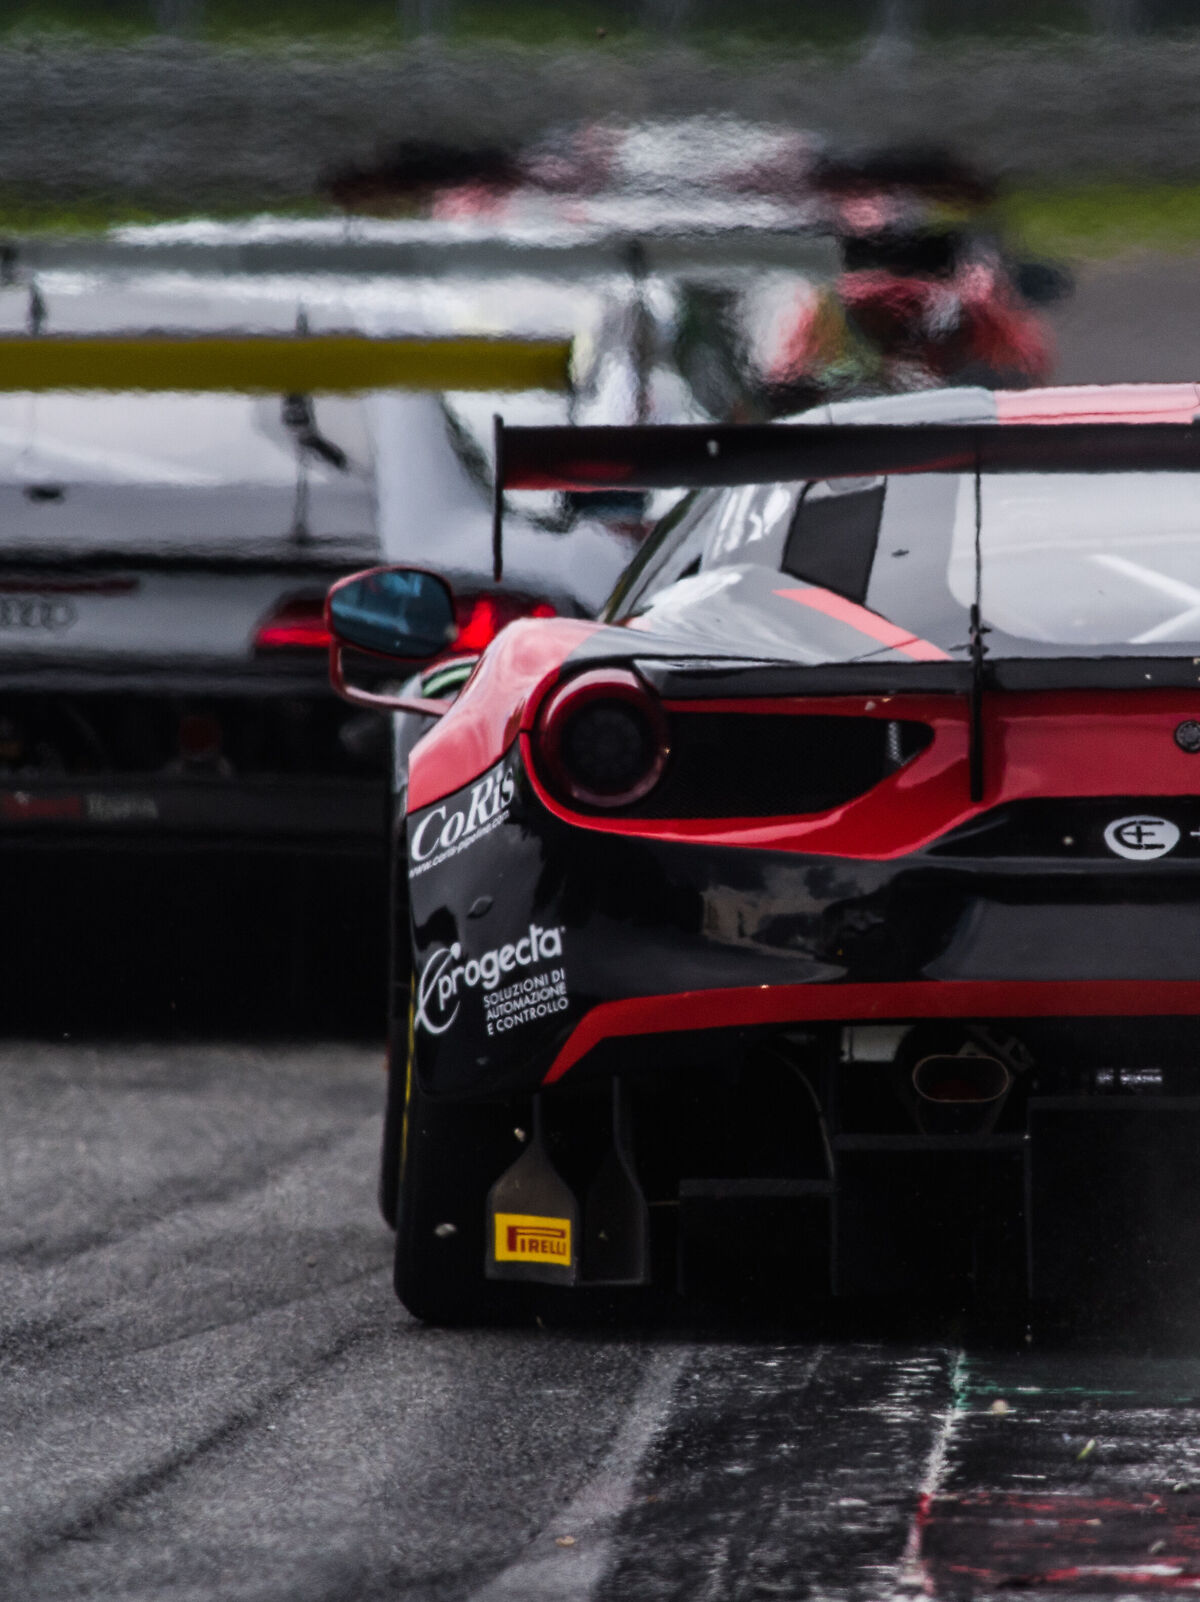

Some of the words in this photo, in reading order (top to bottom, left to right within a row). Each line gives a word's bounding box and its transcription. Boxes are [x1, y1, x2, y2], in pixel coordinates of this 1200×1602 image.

[411, 767, 515, 862] CoRis
[438, 923, 562, 1011] progecta
[484, 973, 549, 1008] SOLUZIONI
[552, 968, 565, 984] DI
[487, 981, 567, 1020] AUTOMAZIONE
[487, 1023, 494, 1035] E
[496, 997, 569, 1032] CONTROLLO
[507, 1225, 567, 1257] PIRELLI
